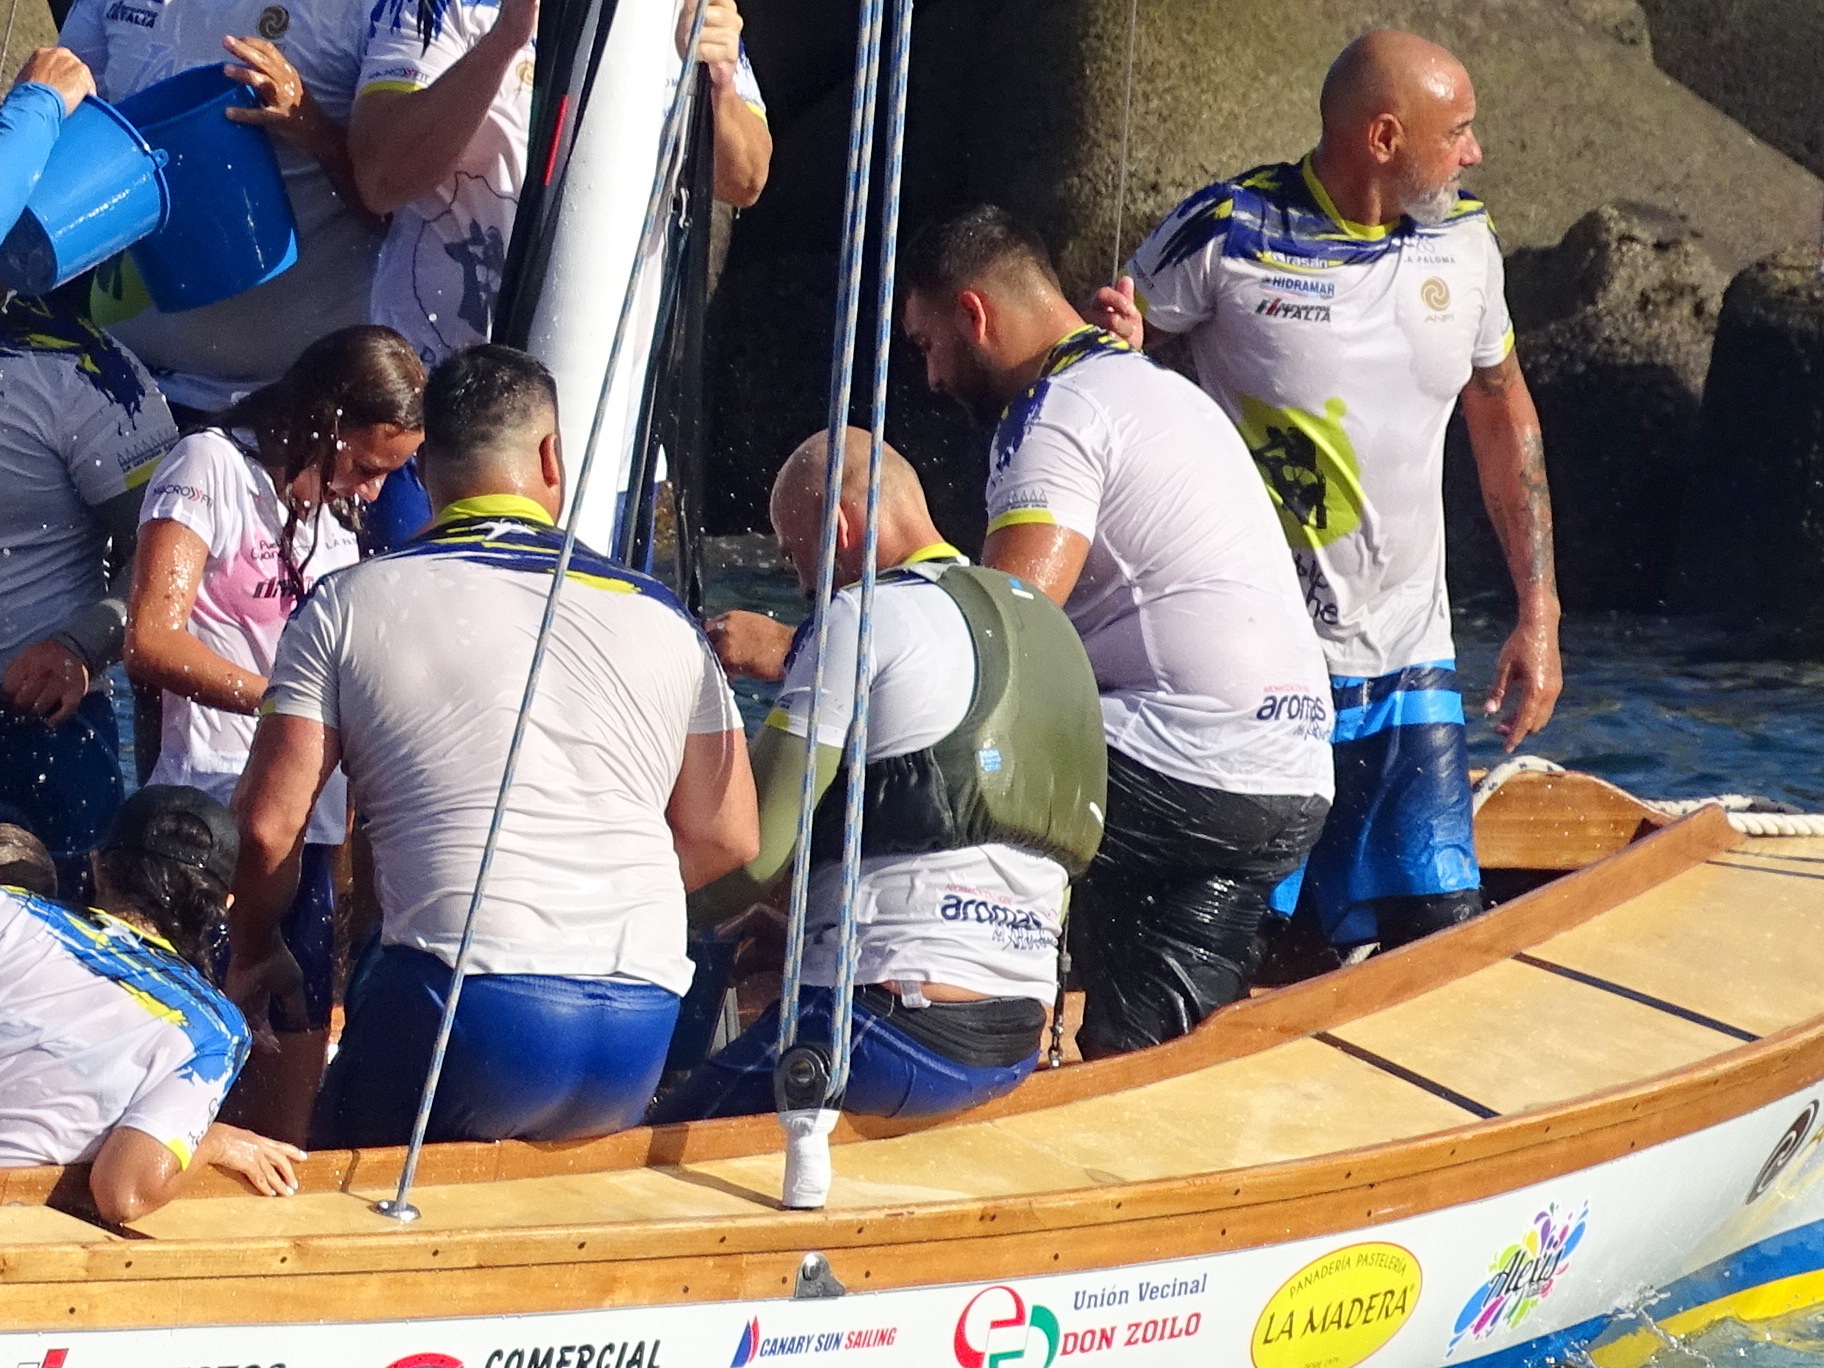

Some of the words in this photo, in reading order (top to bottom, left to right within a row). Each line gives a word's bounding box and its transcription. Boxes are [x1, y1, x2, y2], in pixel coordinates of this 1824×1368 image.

[1273, 277, 1335, 295] HIDRAMAR
[1073, 1285, 1130, 1311] Unión
[1138, 1273, 1208, 1302] Vecinal
[1289, 1254, 1352, 1299] PANADERÍA
[1356, 1252, 1408, 1278] PASTELERÍA
[1060, 1325, 1118, 1357] DON
[1124, 1312, 1202, 1347] ZOILO
[1262, 1309, 1295, 1346] LA
[1300, 1285, 1409, 1339] MADERA
[484, 1339, 661, 1368] COMERCIAL
[759, 1334, 815, 1358] CANARY
[814, 1332, 845, 1353] SUN
[844, 1327, 898, 1350] SAILING
